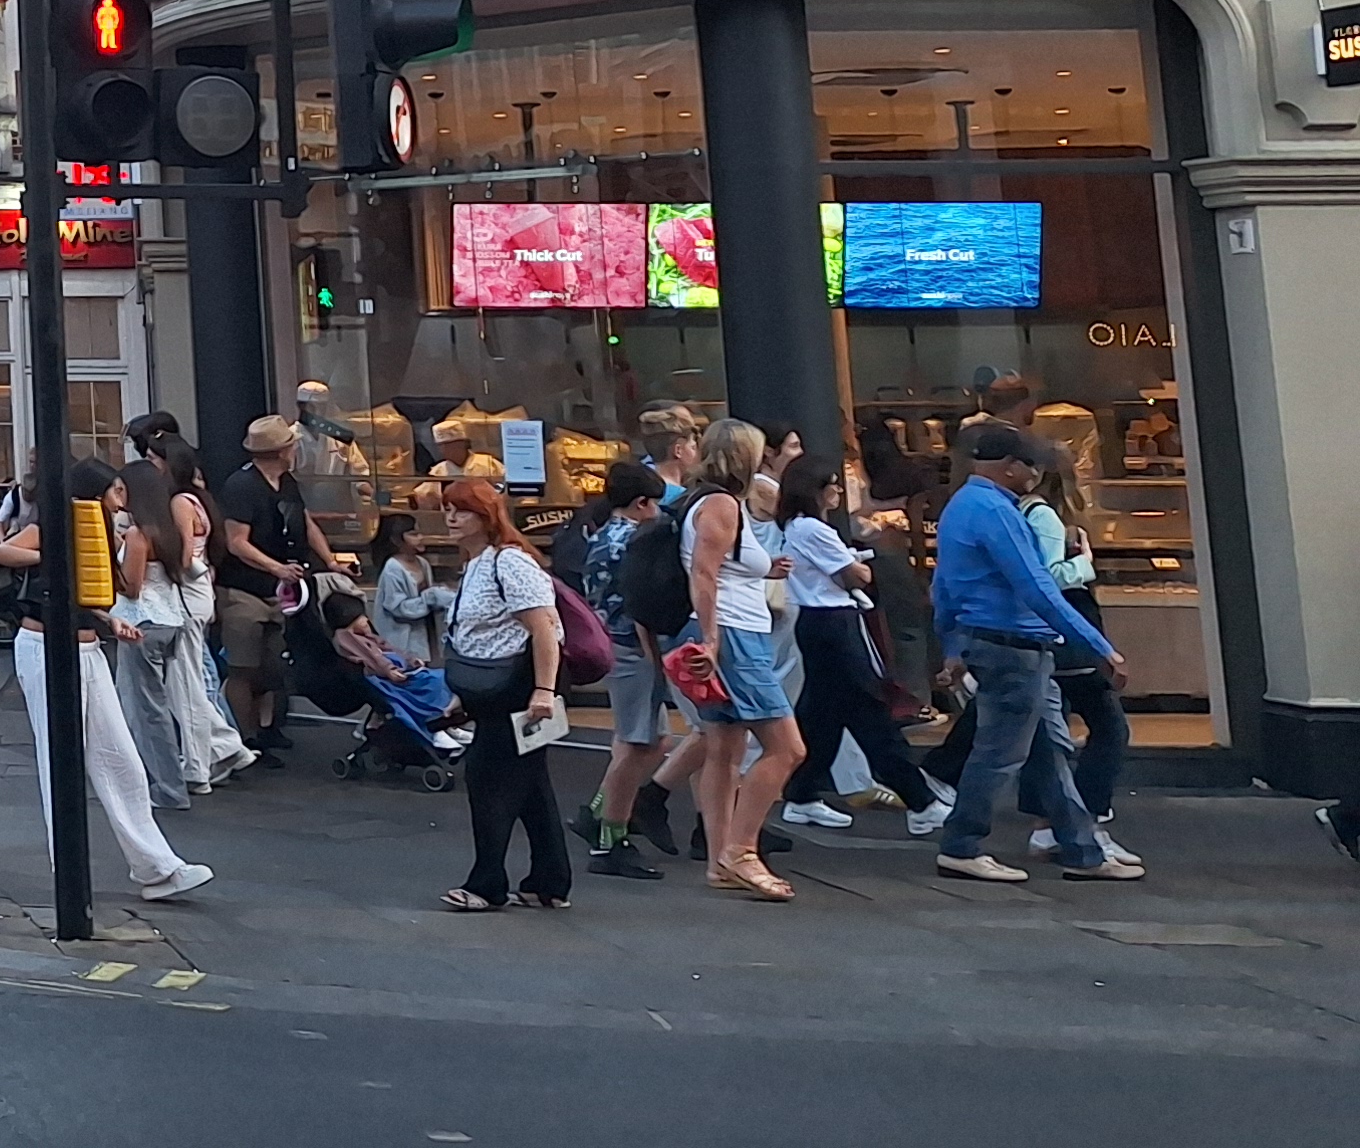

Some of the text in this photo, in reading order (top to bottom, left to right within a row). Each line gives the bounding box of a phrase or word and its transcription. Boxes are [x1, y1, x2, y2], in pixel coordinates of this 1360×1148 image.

[58, 220, 133, 244] Mine
[513, 248, 583, 262] Thick Cut
[905, 248, 975, 262] Fresh Cut
